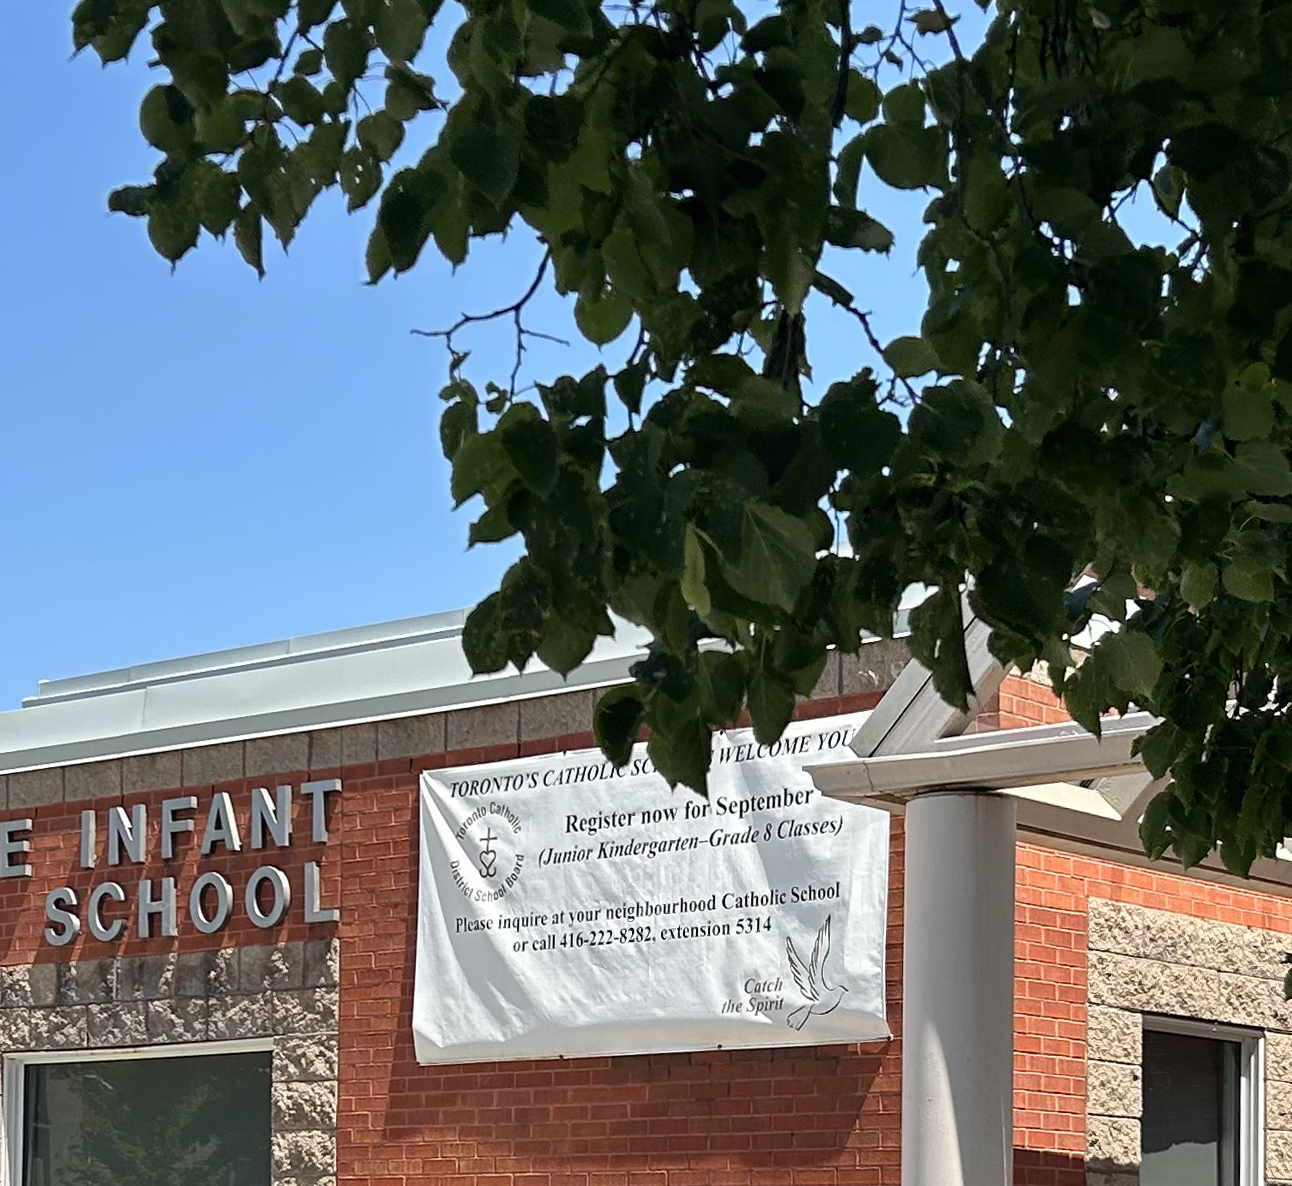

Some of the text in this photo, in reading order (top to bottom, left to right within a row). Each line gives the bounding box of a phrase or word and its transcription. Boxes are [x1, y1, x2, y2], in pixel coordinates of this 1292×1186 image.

[450, 772, 539, 798] TORONTO'S
[543, 763, 626, 788] CATHOLIC
[718, 735, 811, 764] WELCOME
[818, 729, 857, 751] YOU
[81, 778, 342, 869] INFANT
[456, 801, 522, 840] Toronto Catholic
[565, 788, 814, 836] Register now for September
[538, 847, 593, 868] (Junior
[763, 823, 772, 842] 8
[777, 815, 843, 840] Classes)
[450, 854, 525, 902] District School Board
[44, 861, 341, 947] SCHOOL
[455, 881, 841, 933] Please inquire at your neighbourhood Catholic School
[513, 916, 772, 952] or call 416-222-8282, extension 5314
[721, 995, 784, 1016] the Spirit
[744, 977, 783, 994] Catch
